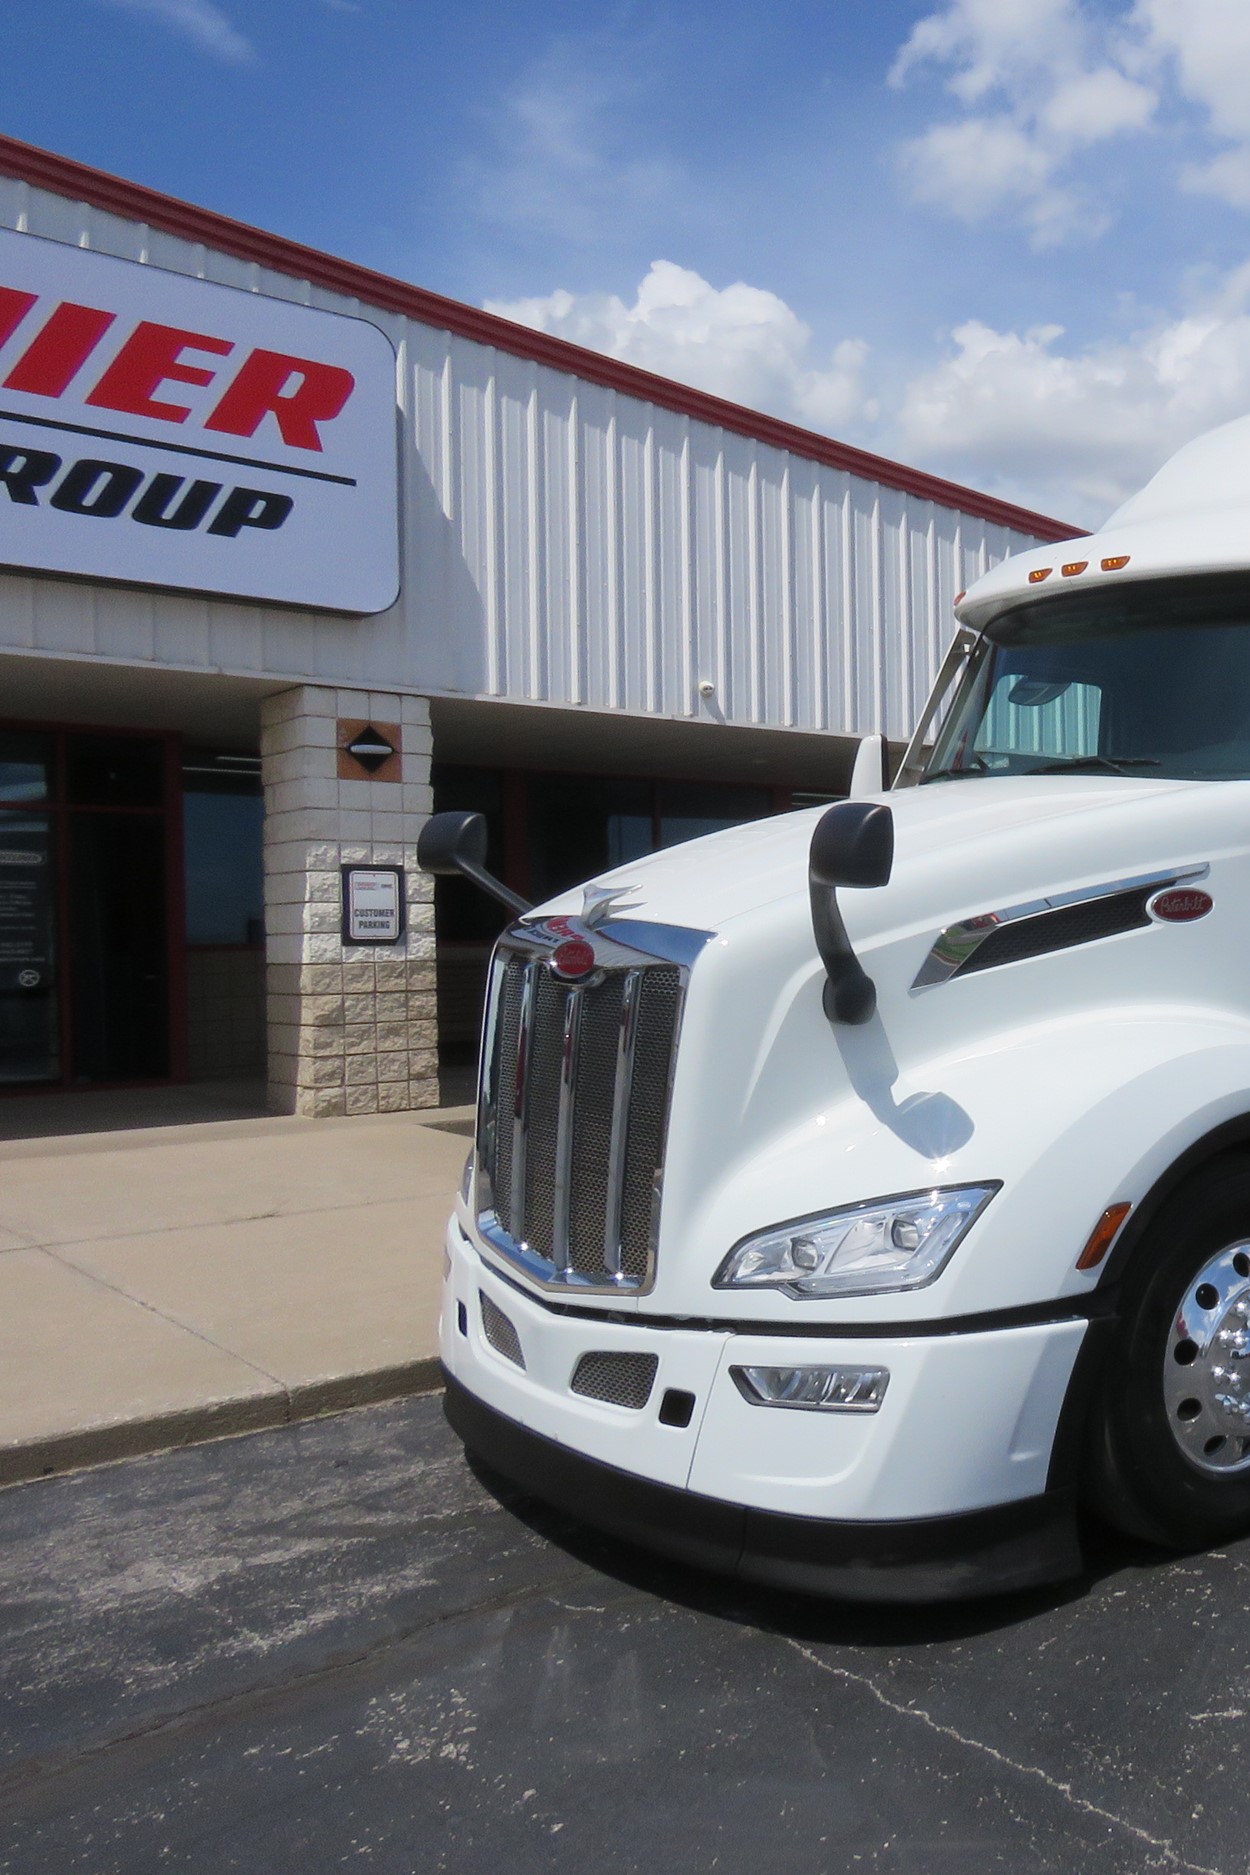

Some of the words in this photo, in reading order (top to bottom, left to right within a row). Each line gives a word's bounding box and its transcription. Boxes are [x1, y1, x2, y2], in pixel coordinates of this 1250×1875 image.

[1160, 895, 1207, 914] Peterbilt
[354, 908, 395, 917] CUSTOMER
[358, 920, 391, 929] PARKING
